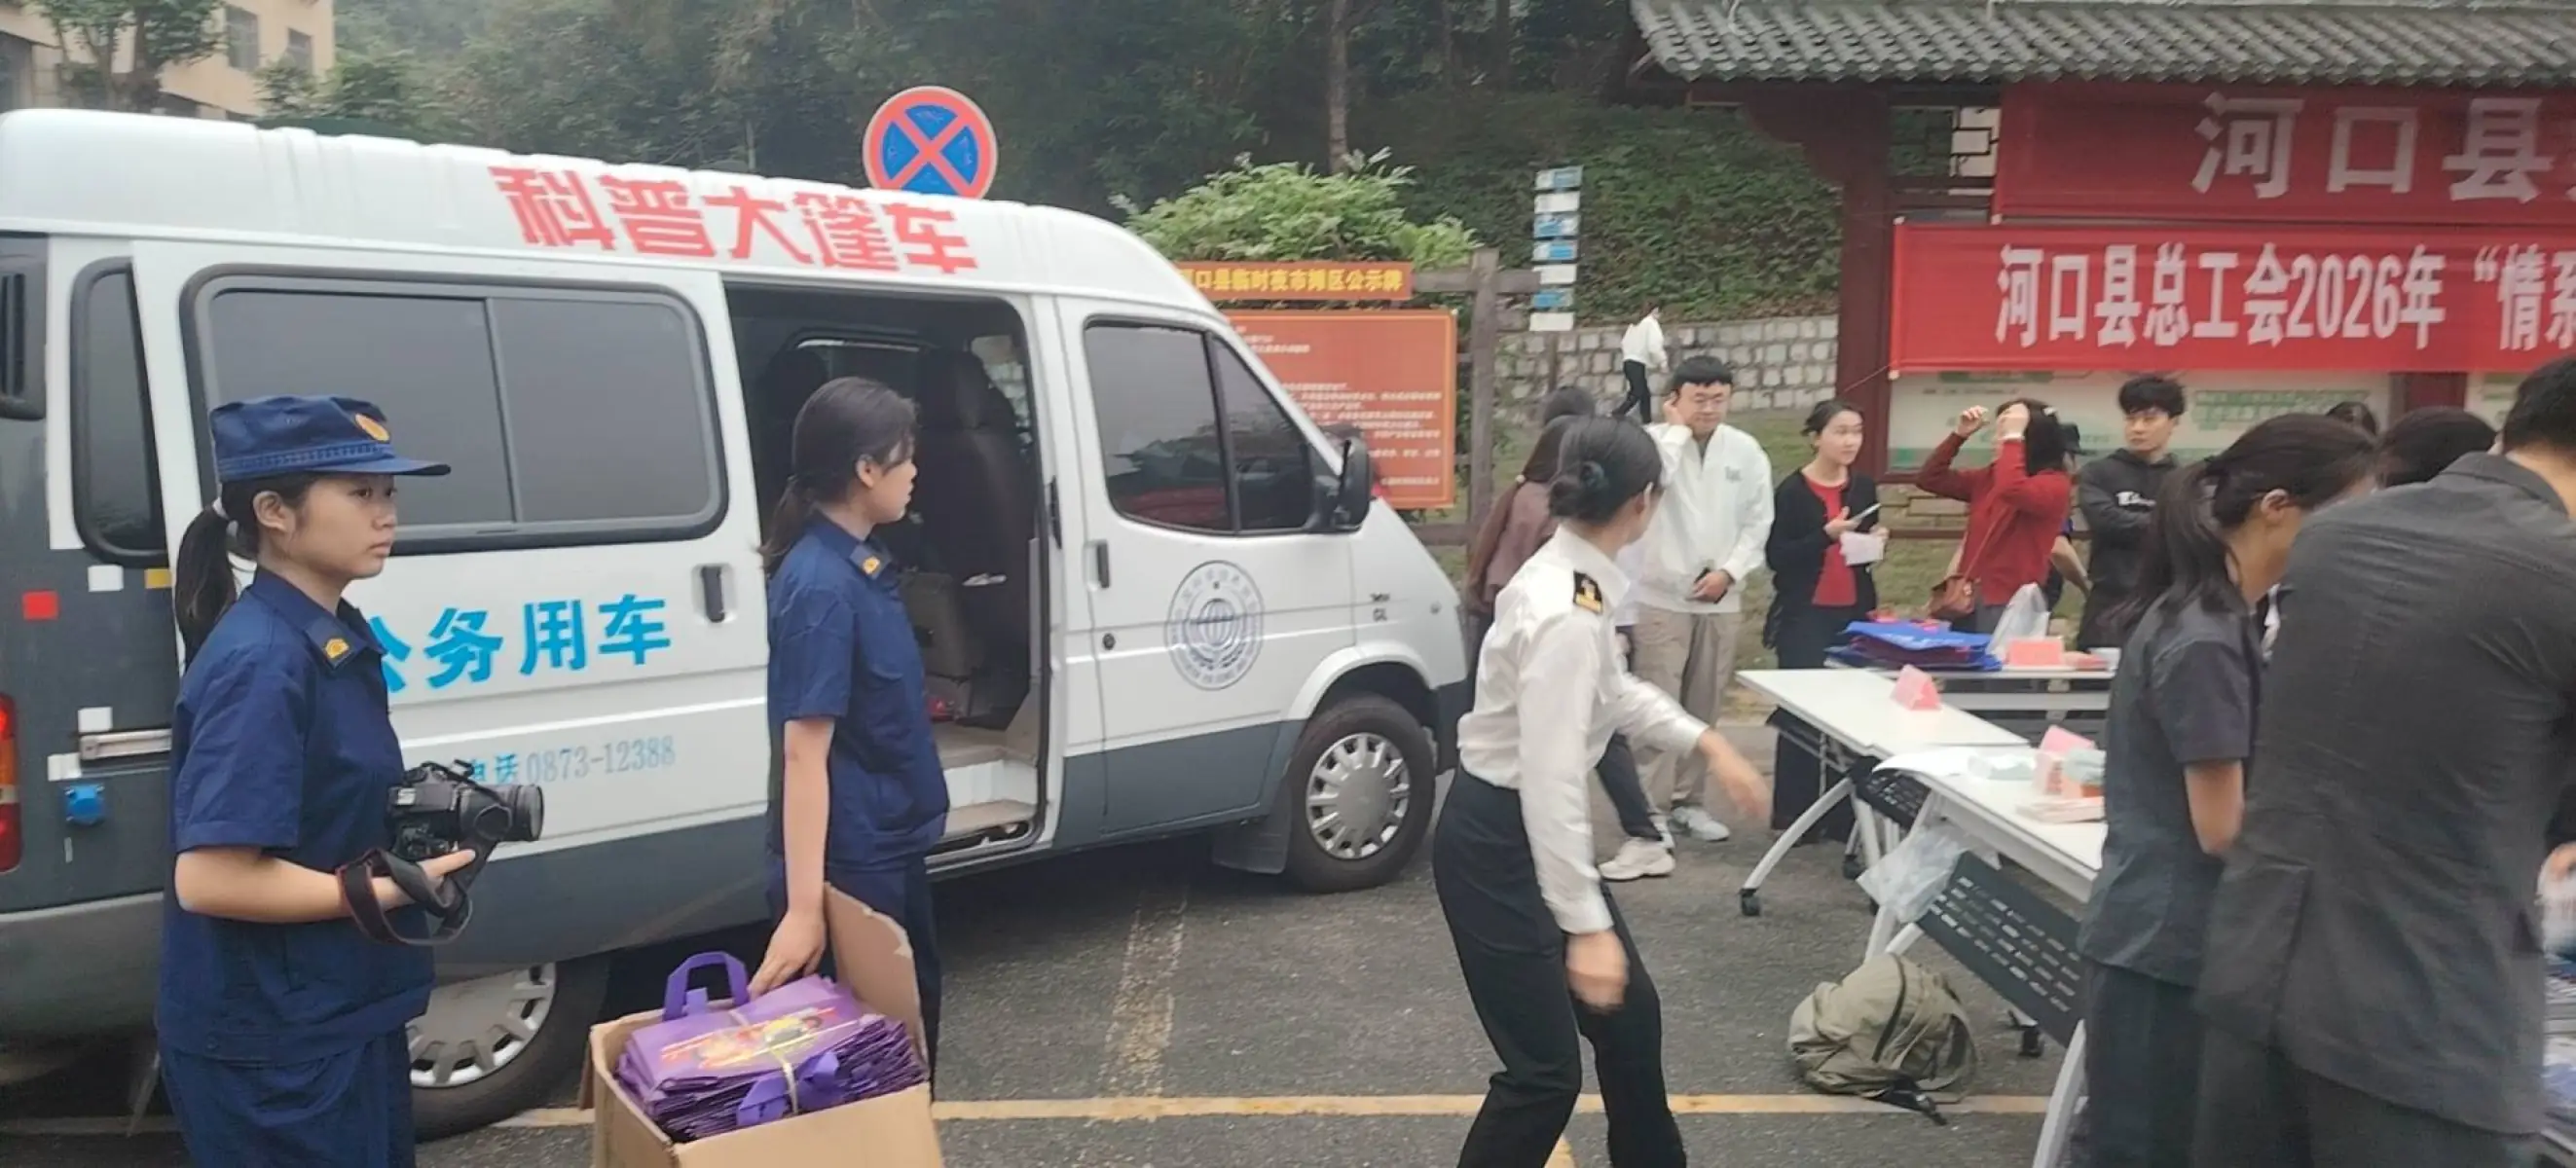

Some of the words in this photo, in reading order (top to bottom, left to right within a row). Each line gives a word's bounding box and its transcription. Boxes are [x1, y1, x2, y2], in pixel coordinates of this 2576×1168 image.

[2190, 91, 2576, 202] 河口县
[488, 165, 979, 274] 科普大篷车
